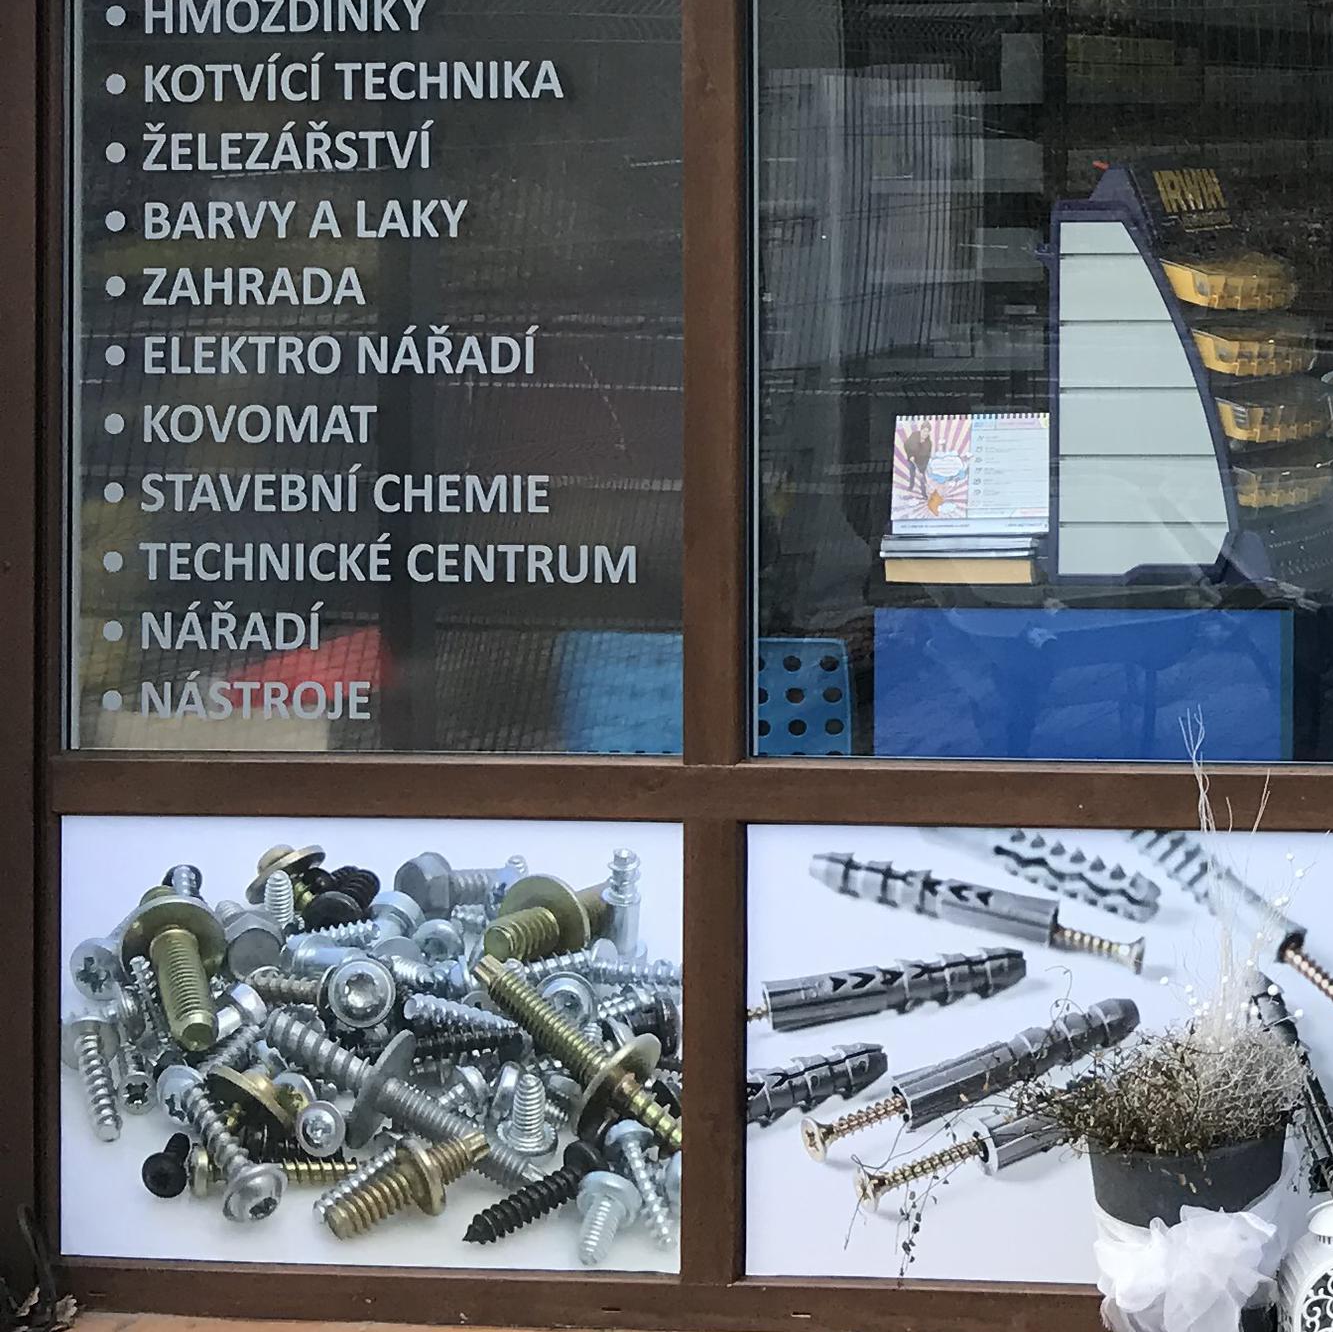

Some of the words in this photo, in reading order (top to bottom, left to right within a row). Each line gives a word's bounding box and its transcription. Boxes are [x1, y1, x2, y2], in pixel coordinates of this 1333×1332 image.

[143, 52, 325, 103] KOTVÍCÍ
[335, 59, 564, 101] TECHNIKA
[142, 120, 435, 171] ŽELEZÁŘSTVÍ
[143, 200, 296, 240] BARVY
[308, 200, 342, 240] A
[356, 199, 469, 239] LAKY
[142, 266, 366, 306] ZAHRADA
[143, 335, 341, 375] ELEKTRO
[357, 325, 540, 375] NÁŘADÍ
[142, 404, 378, 444] KOVOMAT
[139, 463, 363, 514] STAVEBNÍ
[373, 473, 550, 514] CHEMIE
[139, 533, 392, 583] TECHNICKÉ
[406, 544, 638, 585] CENTRUM
[140, 601, 324, 651] NÁŘADÍ
[140, 670, 372, 722] NÁSTROJE
